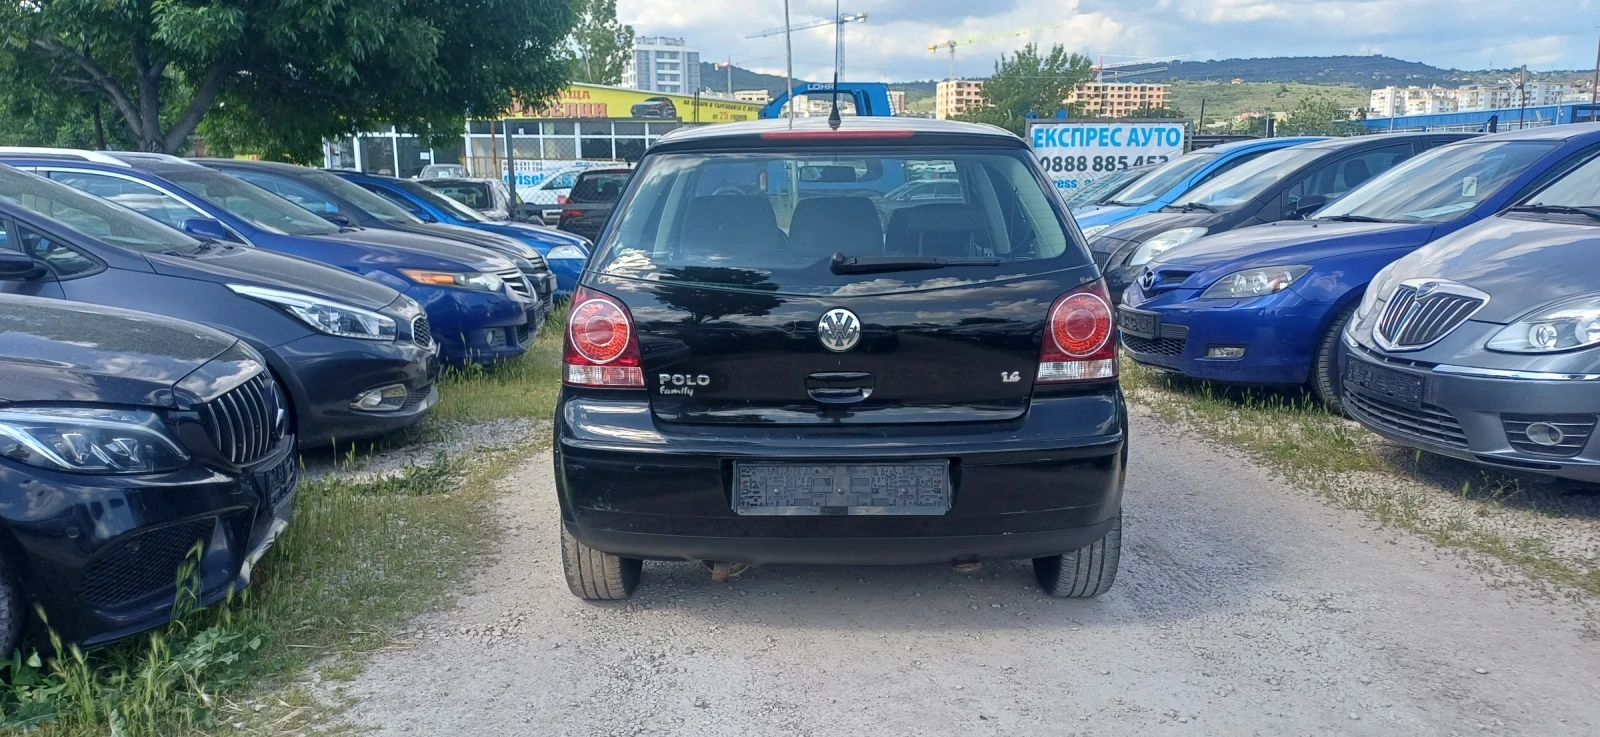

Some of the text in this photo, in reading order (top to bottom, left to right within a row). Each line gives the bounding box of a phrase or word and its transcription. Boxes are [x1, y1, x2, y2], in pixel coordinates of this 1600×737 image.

[719, 111, 729, 120] 25
[1034, 127, 1181, 148] ЕКСПРЕС АУТО
[1040, 155, 1088, 172] 0888
[1092, 155, 1129, 172] 885
[659, 373, 710, 386] POLO
